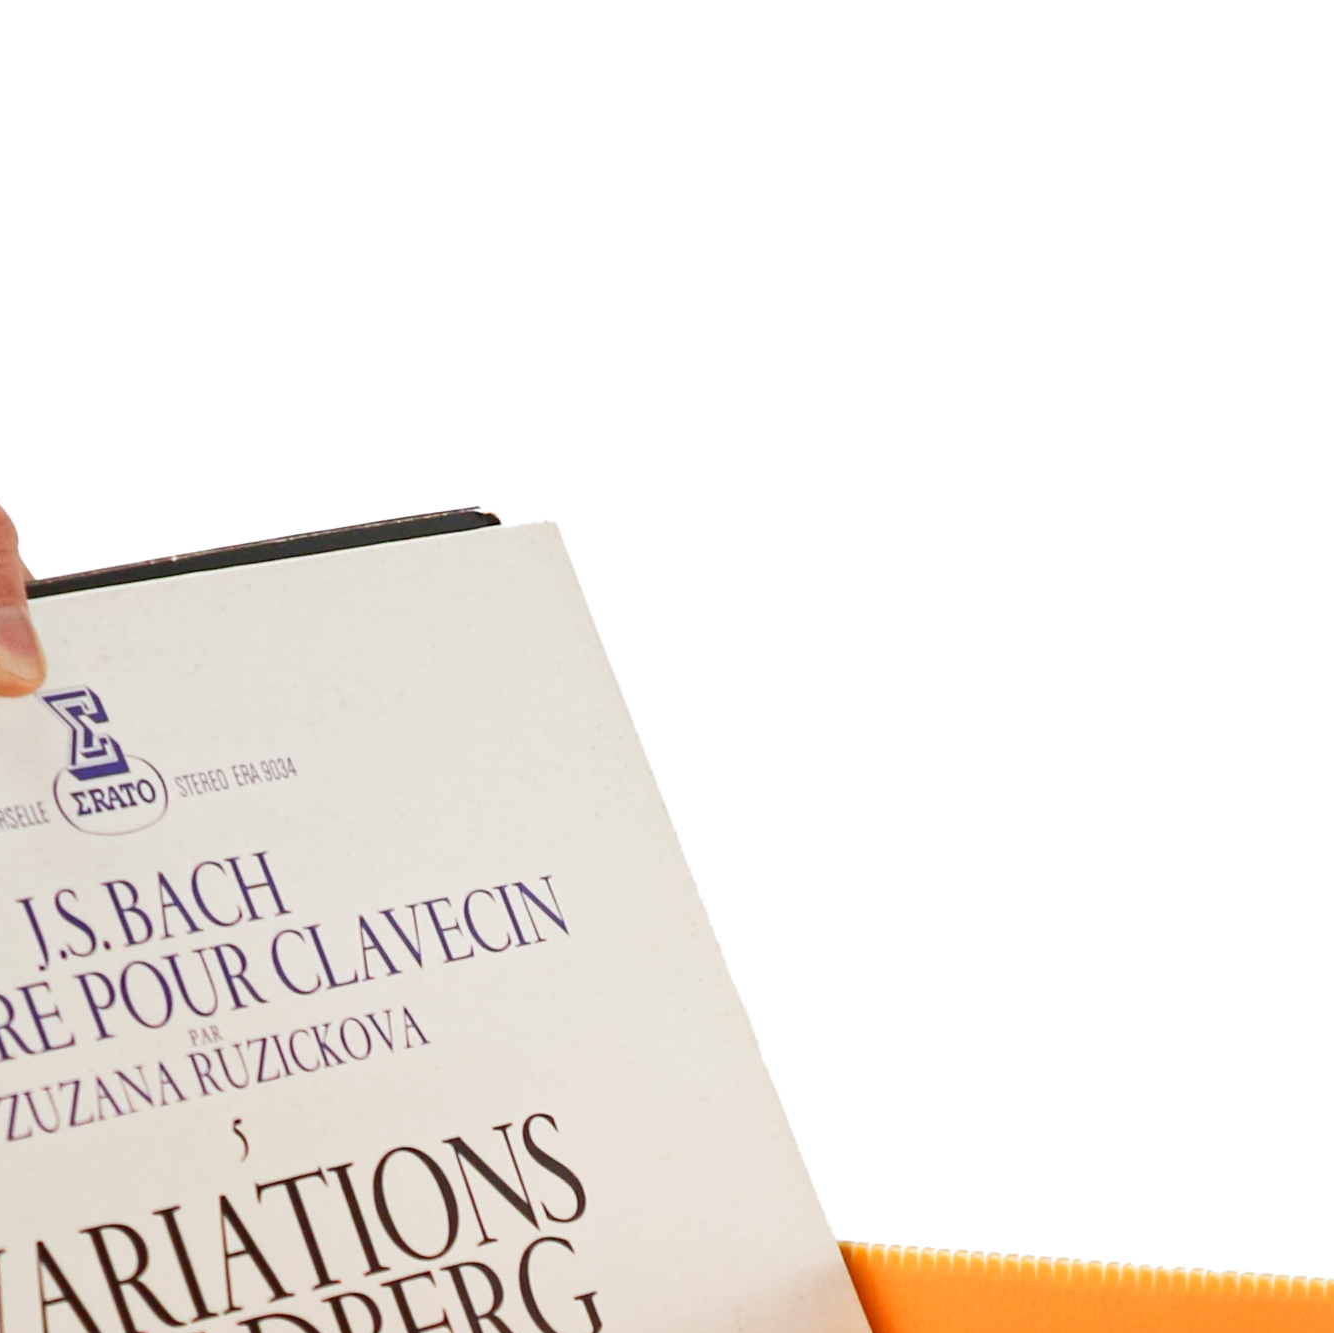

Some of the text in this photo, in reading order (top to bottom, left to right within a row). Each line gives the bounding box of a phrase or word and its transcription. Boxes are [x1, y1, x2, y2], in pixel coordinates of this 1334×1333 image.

[174, 756, 298, 799] STEREO ERA 9034
[73, 942, 269, 1042] POUR
[270, 875, 571, 996] CLAVECIN
[188, 1024, 224, 1047] PAR
[188, 1005, 432, 1097] RUZICKOVA
